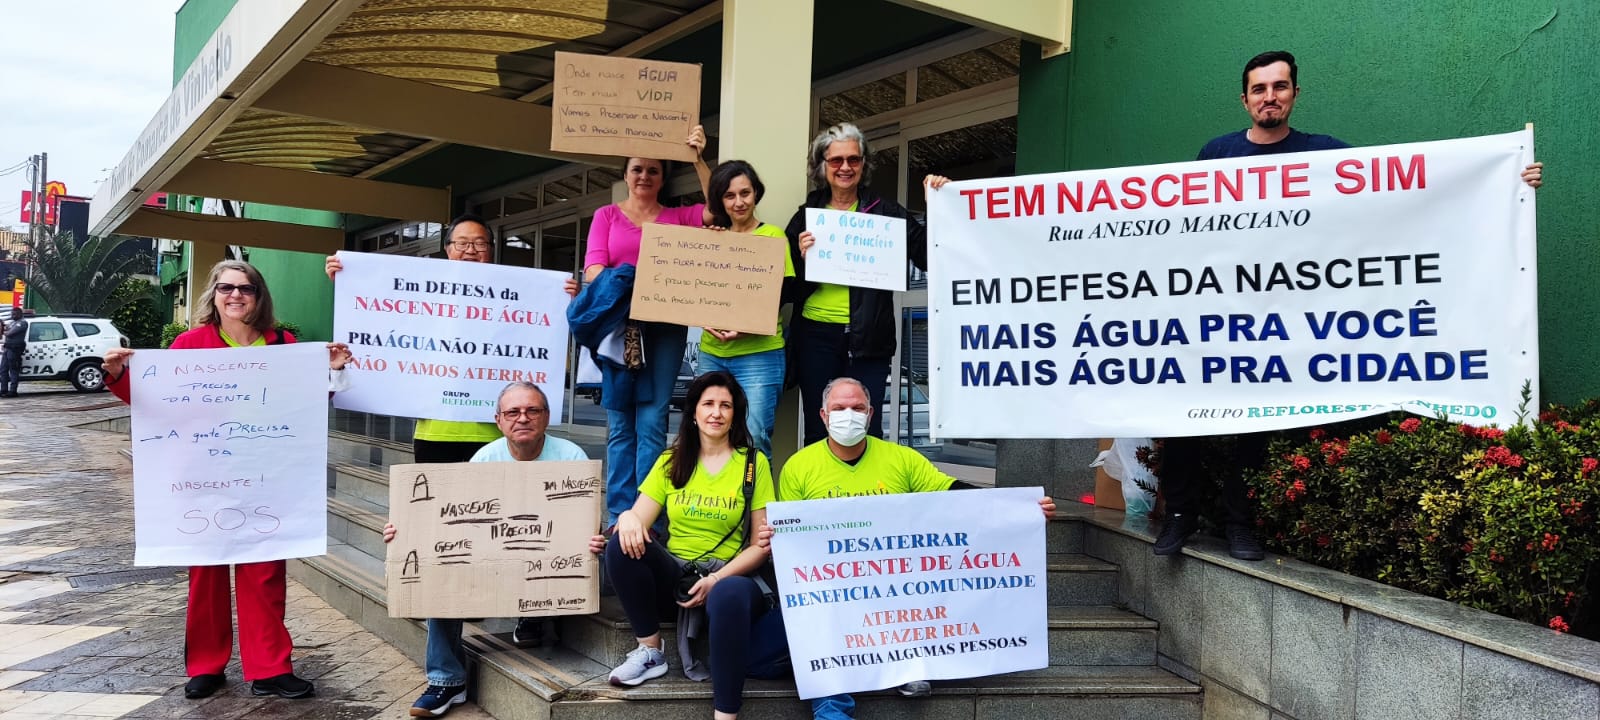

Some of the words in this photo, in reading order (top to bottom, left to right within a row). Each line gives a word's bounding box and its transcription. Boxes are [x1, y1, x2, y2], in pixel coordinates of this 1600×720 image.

[183, 31, 232, 118] Vinhedo
[564, 63, 591, 80] Onde
[638, 66, 678, 82] ÁGUA
[563, 86, 586, 98] Tem
[636, 87, 673, 101] VIDA
[560, 106, 590, 117] Vamos
[599, 107, 639, 120] Preservar
[652, 112, 688, 122] Nascente
[564, 125, 576, 133] da
[960, 184, 1044, 220] TEM
[1057, 163, 1310, 214] NASCENTE
[1334, 154, 1426, 195] SIM
[816, 213, 825, 226] A
[839, 212, 874, 229] ÁGUA
[1048, 225, 1084, 242] Rua
[1088, 218, 1171, 240] ANESIO
[1180, 208, 1311, 234] MARCIANO
[652, 236, 672, 248] Tem
[677, 241, 721, 252] NASCENTE
[829, 233, 836, 243] O
[650, 255, 669, 266] Tem
[673, 257, 695, 267] FLORA
[704, 260, 732, 270] FAUNA
[818, 249, 832, 259] DE
[845, 251, 876, 264] TUDO
[735, 282, 743, 290] a
[952, 278, 1001, 305] EM
[1010, 269, 1158, 303] DEFESA
[1168, 266, 1223, 296] DA
[1236, 253, 1442, 293] NASCETE
[392, 277, 420, 293] Em
[425, 280, 495, 299] DEFESA
[500, 288, 519, 301] da
[653, 293, 667, 303] Rua
[354, 296, 459, 319] NASCENTE
[465, 305, 493, 321] DE
[498, 305, 551, 327] ÁGUA
[960, 322, 1057, 350] MAIS
[1072, 313, 1190, 348] ÁGUA
[1200, 313, 1290, 342] PRA
[1304, 299, 1438, 341] VOCÊ
[348, 331, 383, 347] PRA
[384, 329, 437, 352] ÁGUA
[439, 337, 477, 355] NÃO
[481, 343, 549, 361] FALTAR
[142, 364, 157, 379] A
[174, 362, 269, 376] NASCENTE
[350, 354, 388, 372] NÃO
[397, 360, 459, 379] VAMOS
[463, 367, 547, 384] ATERRAR
[961, 359, 1058, 387] MAIS
[1068, 352, 1186, 385] ÁGUA
[1202, 355, 1292, 384] PRA
[1308, 349, 1488, 383] CIDADE
[178, 382, 238, 391] PRECISA
[442, 390, 470, 398] GRUPO
[162, 395, 190, 403] DA
[201, 394, 251, 404] GENTE
[441, 397, 497, 407] REFLOREST
[1187, 408, 1243, 419] GRUPO
[1246, 403, 1385, 418] REFLOREST
[167, 429, 180, 439] A
[192, 427, 220, 443] gente
[219, 421, 290, 436] PRECISA
[208, 448, 232, 456] DA
[171, 478, 252, 493] NASCENTE
[412, 472, 430, 499] A
[562, 475, 600, 490] NASCENTE
[440, 498, 500, 518] NASCENTE
[682, 506, 728, 520] Vinhedo
[176, 505, 281, 535] SOS
[772, 518, 801, 526] GRUPO
[773, 524, 830, 534] REFLORESTA
[831, 520, 872, 529] VINHEDO
[434, 538, 473, 553] GENTE
[827, 532, 968, 554] DESATERRAR
[403, 549, 419, 575] A
[527, 560, 542, 572] DA
[551, 553, 583, 571] GENTE
[793, 557, 912, 583] NASCENTE
[920, 554, 952, 572] DE
[958, 550, 1021, 570] ÁGUA
[785, 584, 882, 608] BENEFICIA
[886, 584, 898, 597] A
[902, 575, 1036, 596] COMUNIDADE
[862, 606, 947, 627] ATERRAR
[844, 632, 876, 648] PRA
[880, 626, 937, 645] FAZER
[943, 622, 981, 638] RUA
[810, 652, 883, 672] BENEFICIA
[887, 643, 955, 662] ALGUMAS
[960, 636, 1027, 653] PESSOAS
